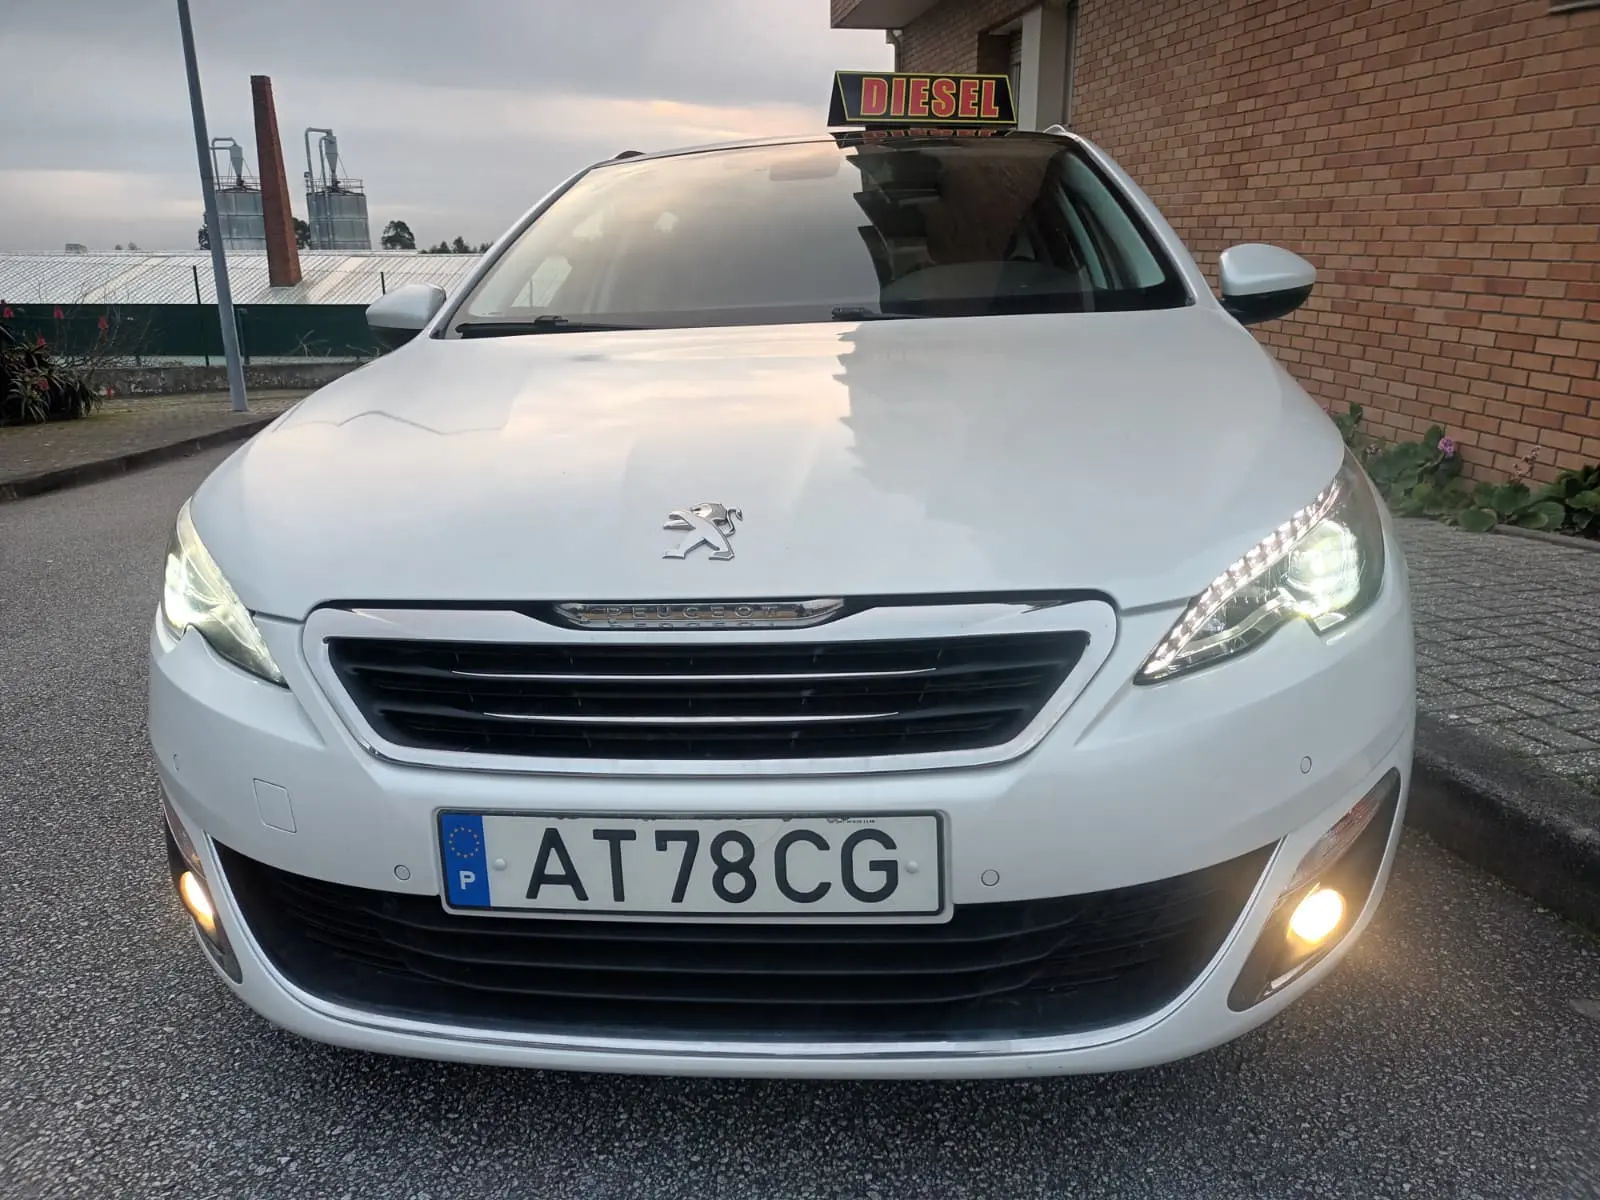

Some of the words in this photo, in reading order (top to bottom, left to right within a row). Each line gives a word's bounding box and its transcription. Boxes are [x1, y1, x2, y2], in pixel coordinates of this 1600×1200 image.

[860, 76, 999, 118] DIESEL
[605, 606, 781, 619] PEUGEOT
[459, 871, 476, 890] P
